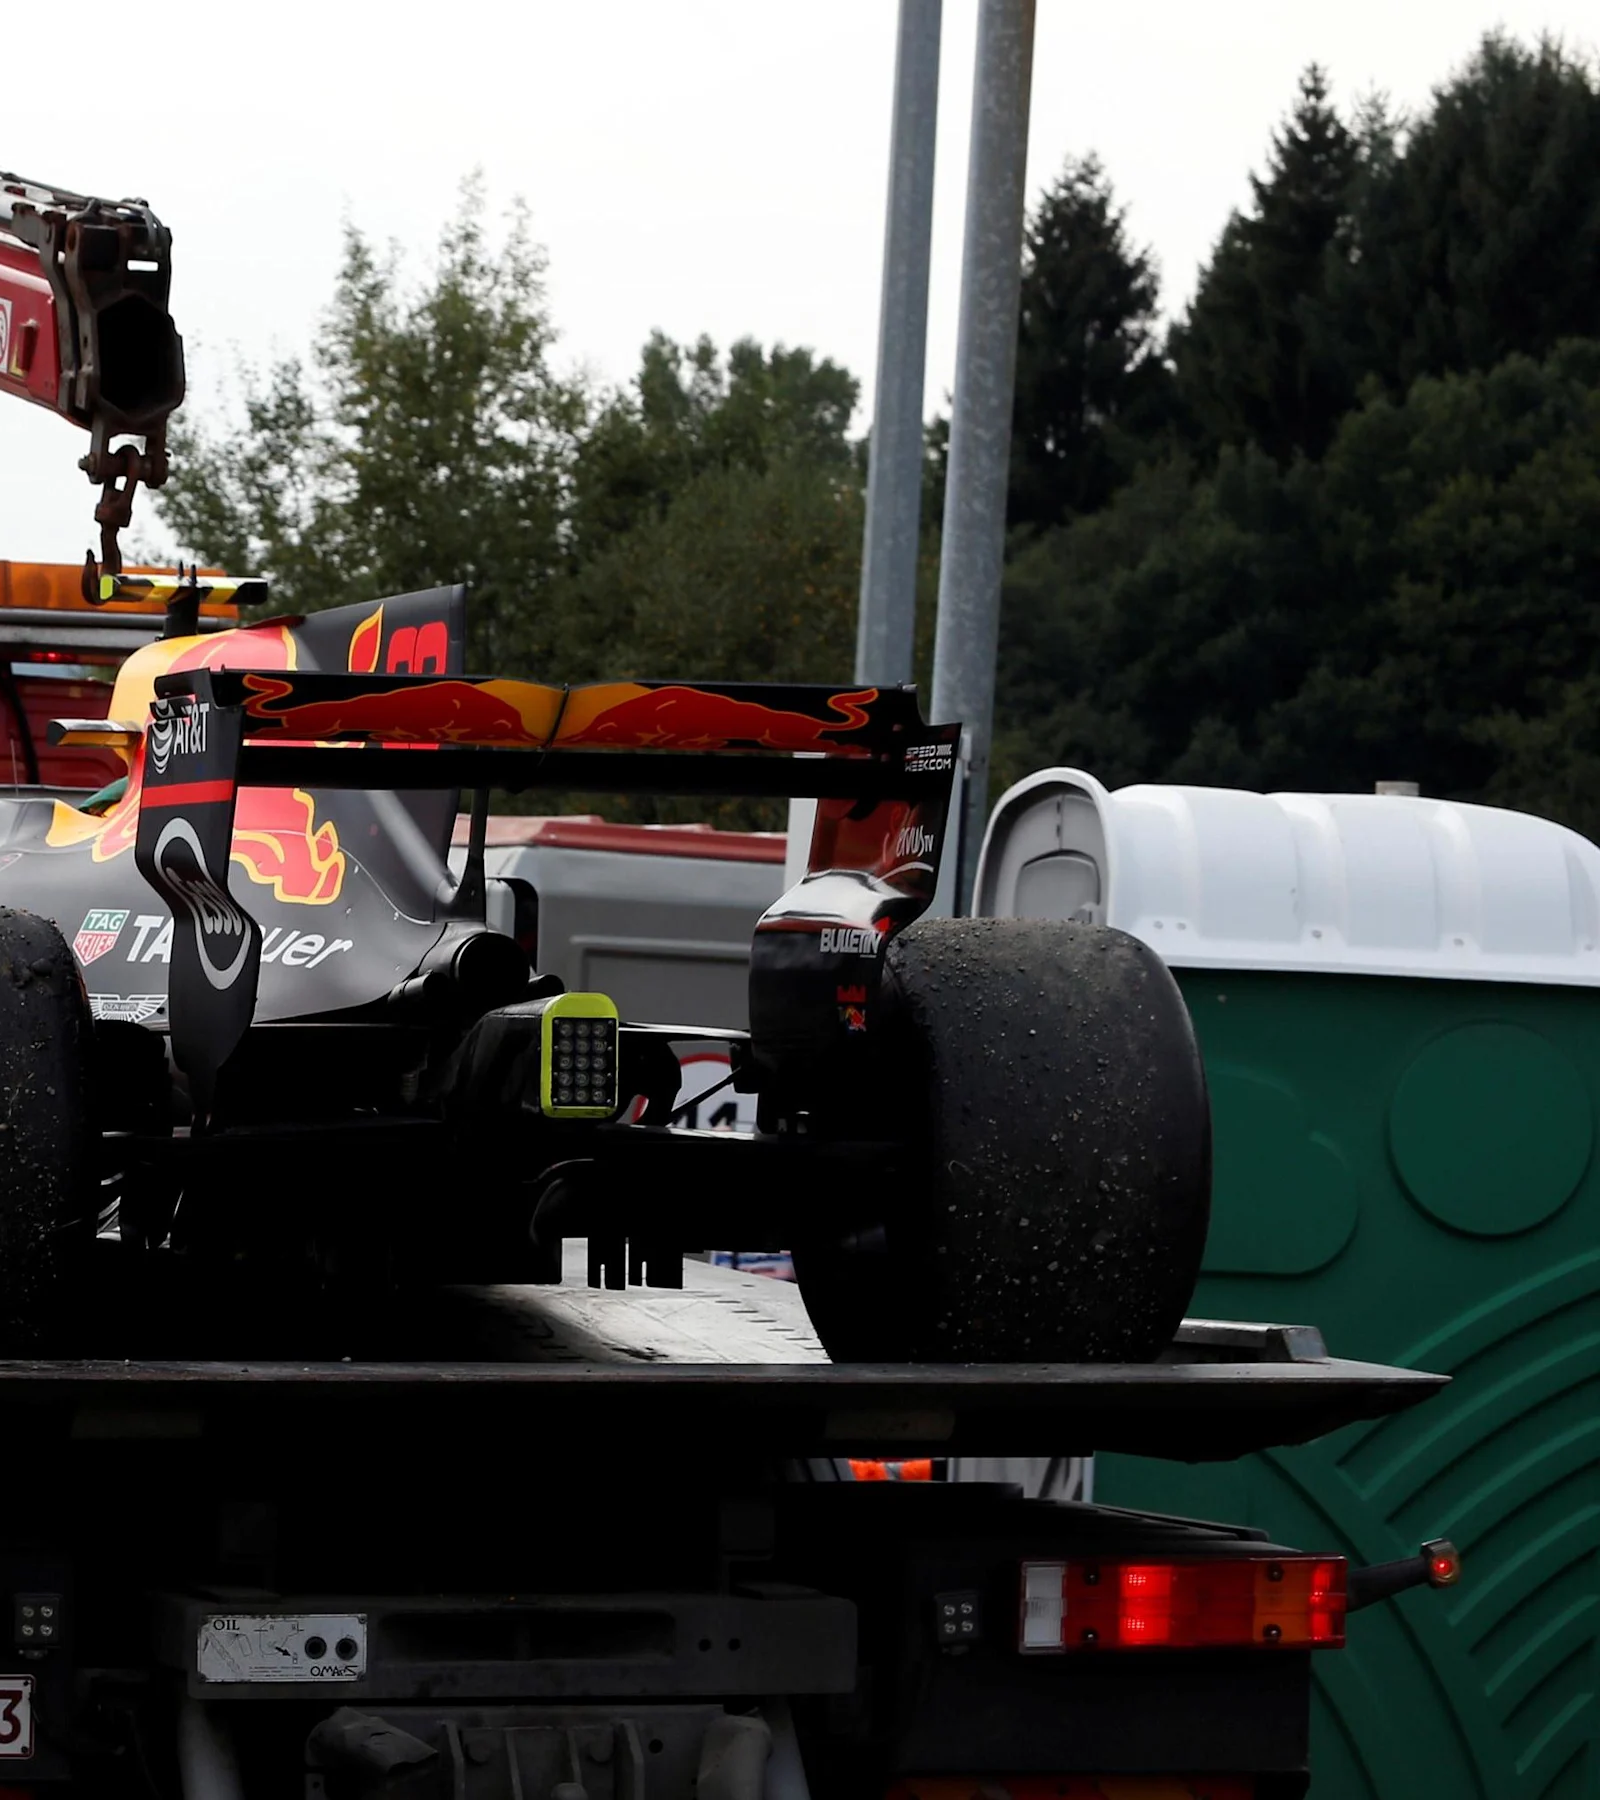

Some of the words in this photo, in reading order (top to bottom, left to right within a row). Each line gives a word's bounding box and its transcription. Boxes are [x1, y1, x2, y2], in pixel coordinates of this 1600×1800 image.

[173, 702, 210, 756] AT&T
[905, 744, 937, 759] SPEED
[88, 913, 124, 930] TAG
[77, 934, 114, 960] HEUER
[213, 1619, 240, 1631] OIL
